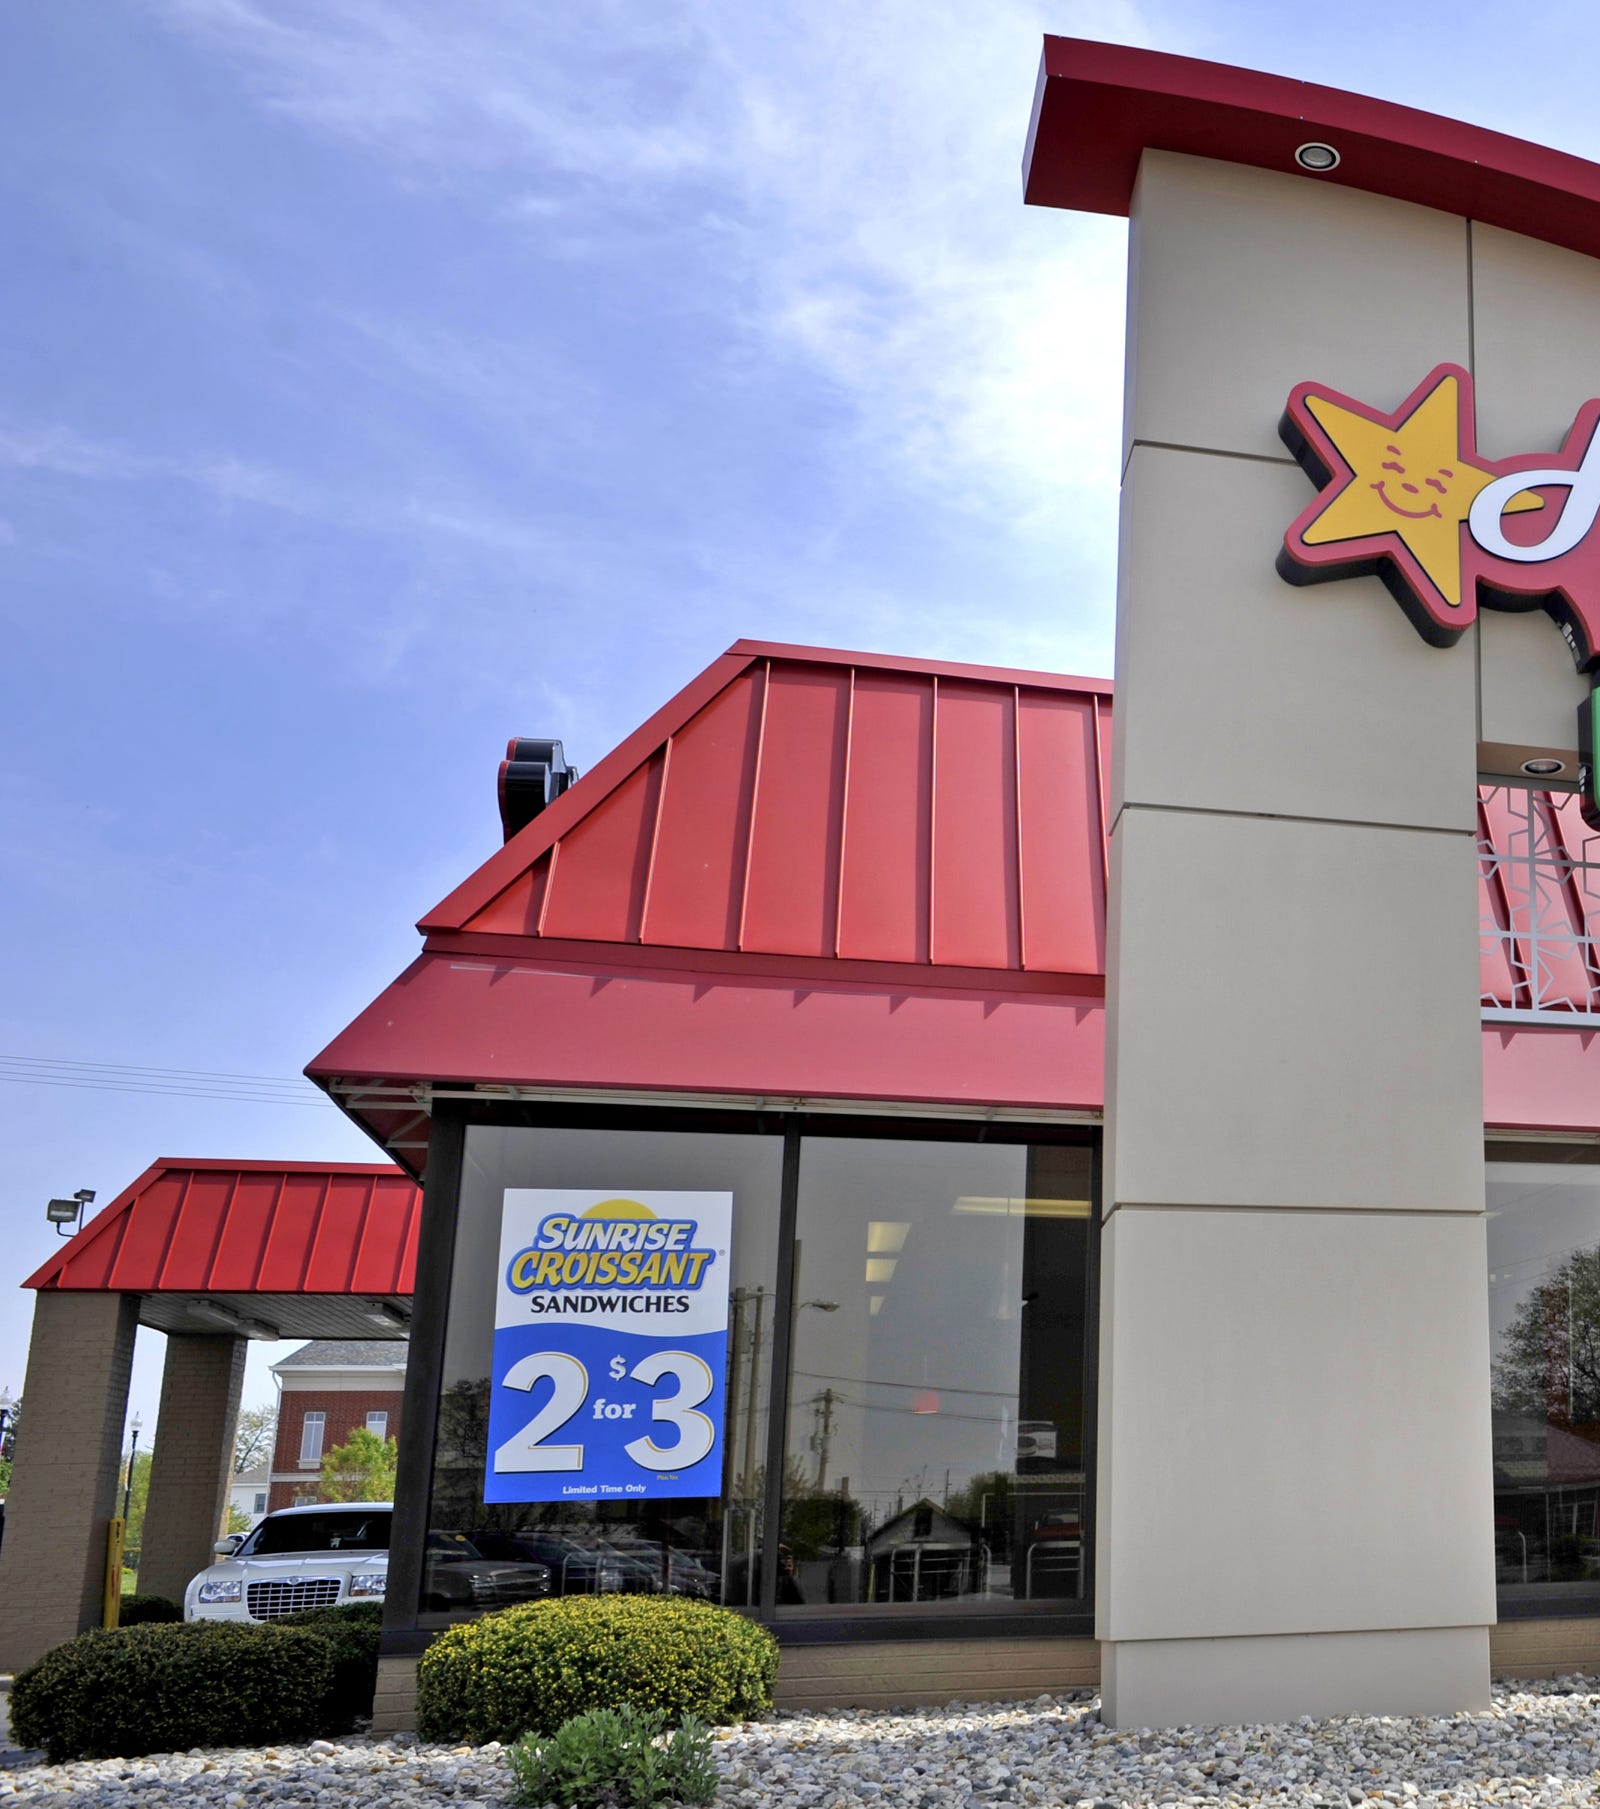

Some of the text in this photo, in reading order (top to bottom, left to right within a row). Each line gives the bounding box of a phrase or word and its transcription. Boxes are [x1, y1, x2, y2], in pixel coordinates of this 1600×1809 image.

[537, 1217, 693, 1252] SUNRISE
[510, 1250, 711, 1290] CROISSANT
[530, 1294, 690, 1314] SANDWICHES
[494, 1351, 590, 1475] 2
[592, 1398, 637, 1420] for
[562, 1484, 647, 1495] Limited Time Only
